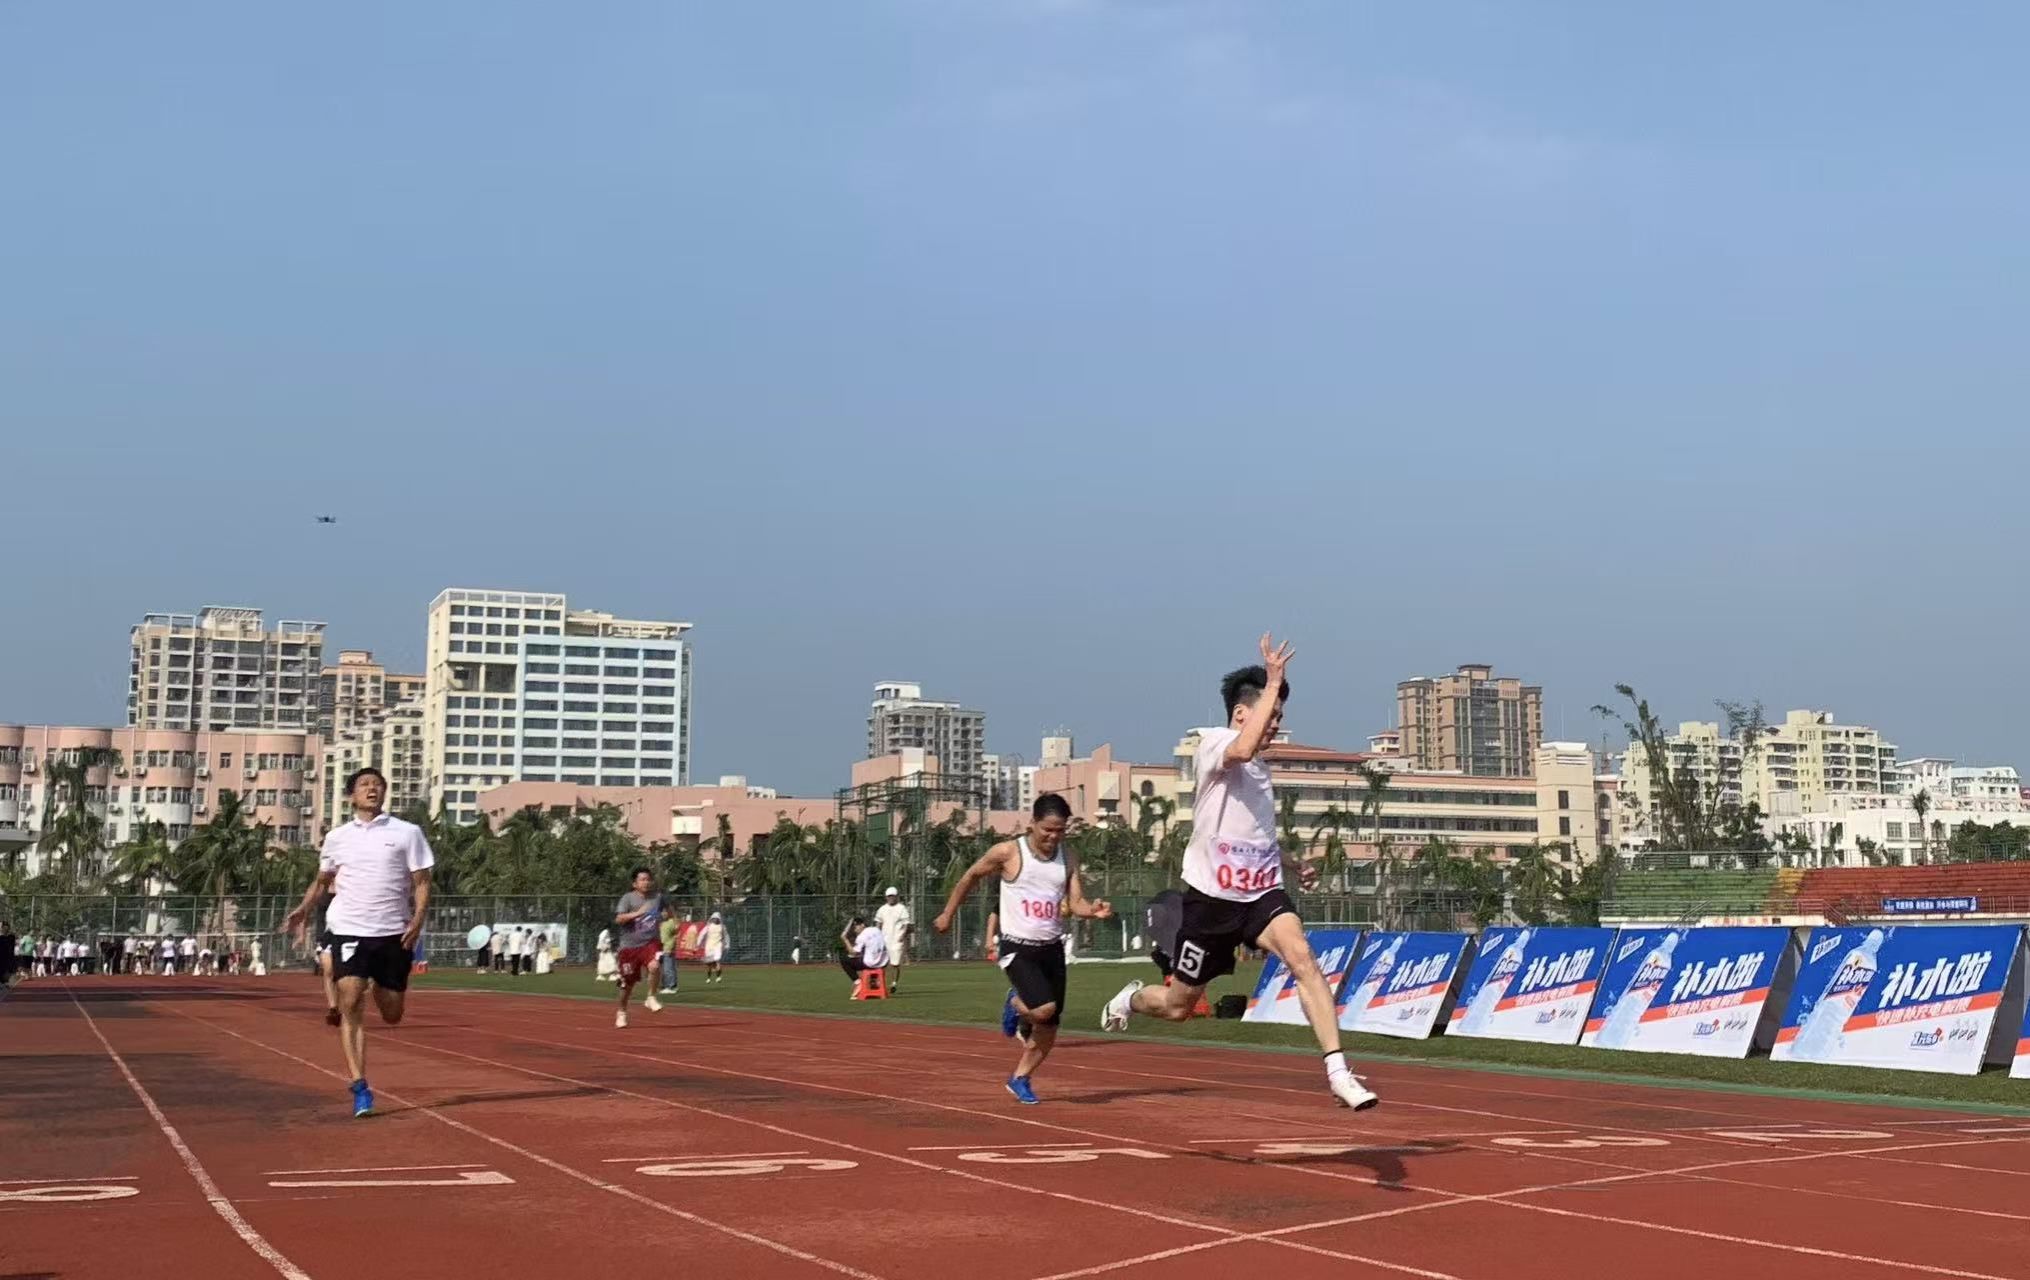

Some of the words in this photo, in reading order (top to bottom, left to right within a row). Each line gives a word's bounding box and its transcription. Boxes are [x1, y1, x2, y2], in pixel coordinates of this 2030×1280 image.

[1182, 945, 1200, 972] 5
[1387, 952, 1451, 993] 补水啦
[1518, 948, 1596, 994] 补水啦
[1670, 952, 1766, 1003] 补水啦
[1880, 951, 1993, 1009] 补水啦
[635, 1158, 859, 1177] 6
[957, 1148, 1172, 1164] 5
[267, 1171, 517, 1187] 7
